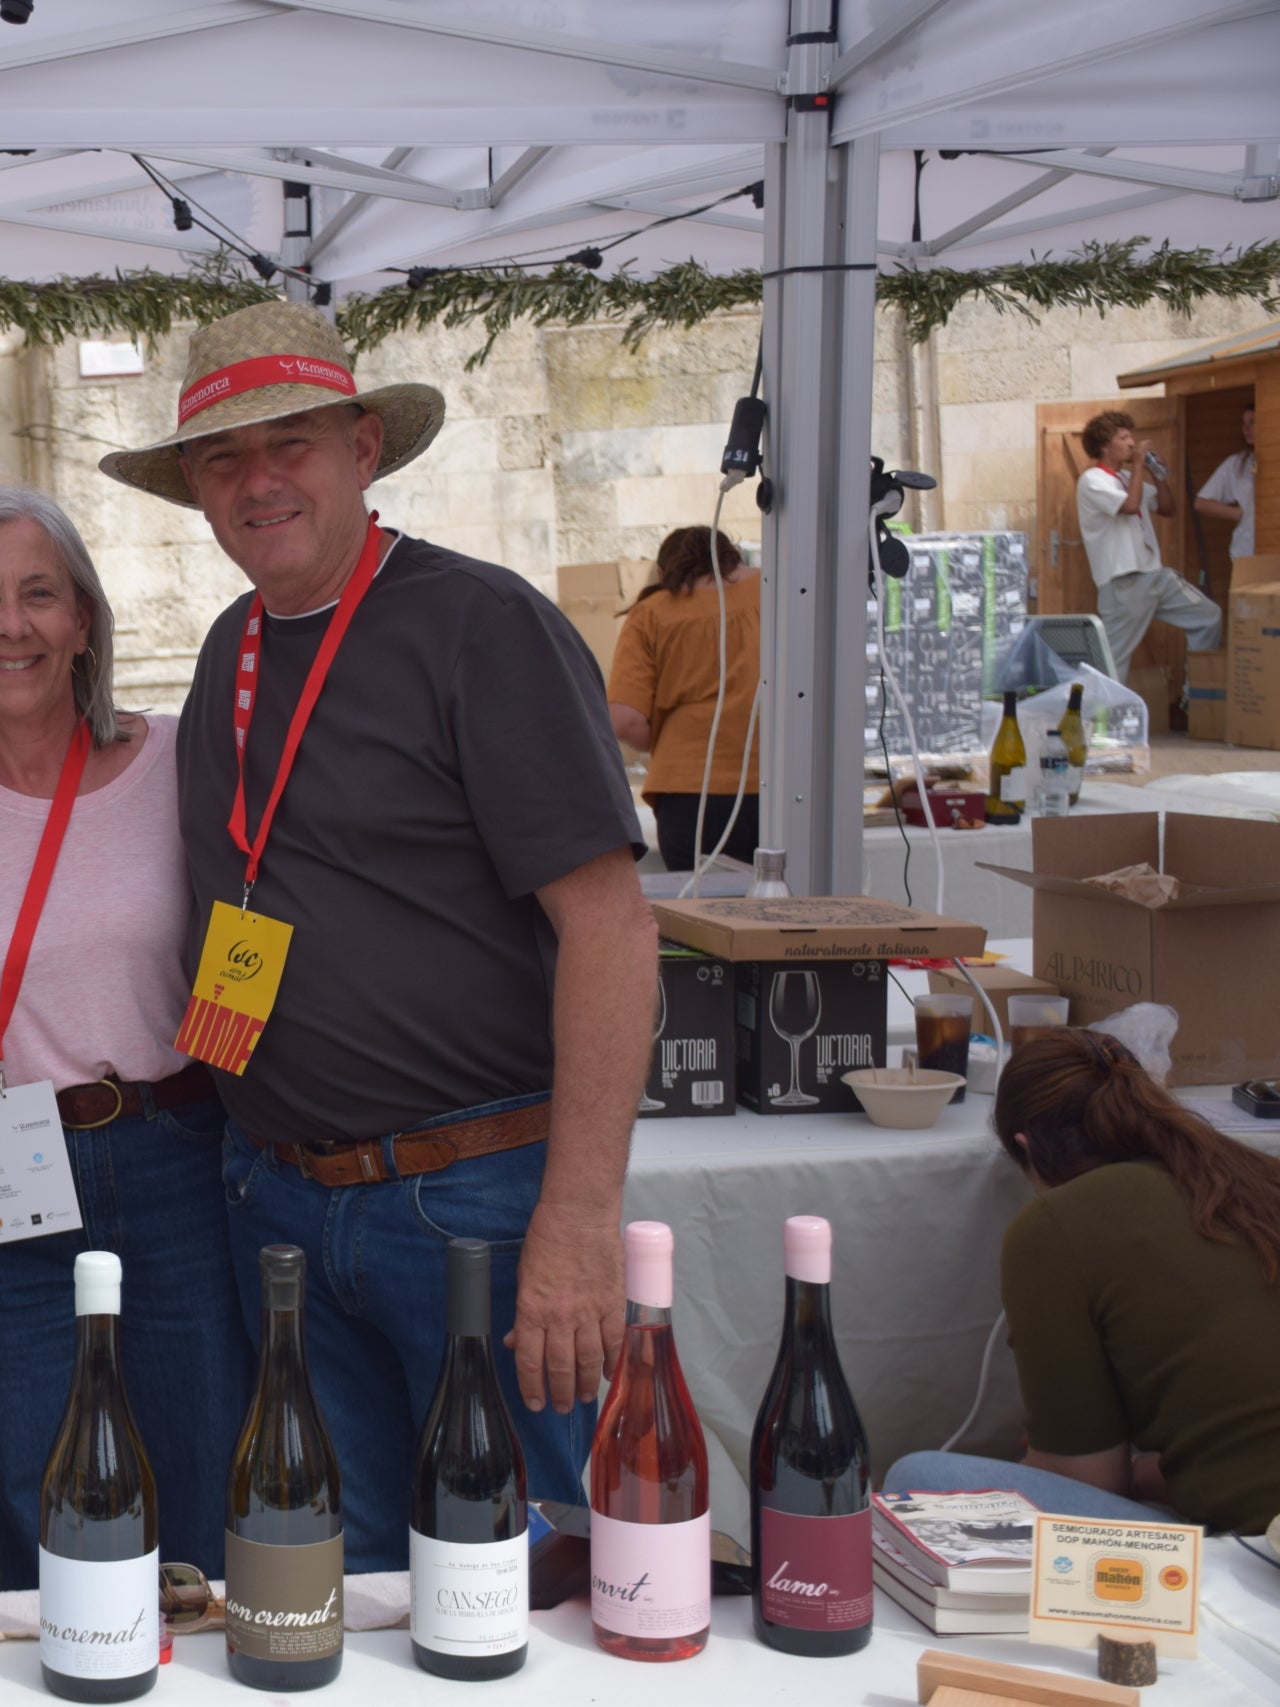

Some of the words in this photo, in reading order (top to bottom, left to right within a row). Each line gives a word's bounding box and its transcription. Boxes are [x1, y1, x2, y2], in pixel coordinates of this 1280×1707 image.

[661, 1038, 717, 1071] VICTORIA
[816, 1034, 872, 1067] VICTORIA
[1052, 1523, 1123, 1537] SEMICURADO
[1126, 1530, 1185, 1542] ARTESANO
[1057, 1535, 1079, 1544] DOP
[1082, 1537, 1179, 1552] MAHÓN-MENORCA
[254, 1587, 336, 1627] cremat
[1048, 1607, 1182, 1625] www.quesomahonmenorca.com
[61, 1608, 146, 1645] cremat
